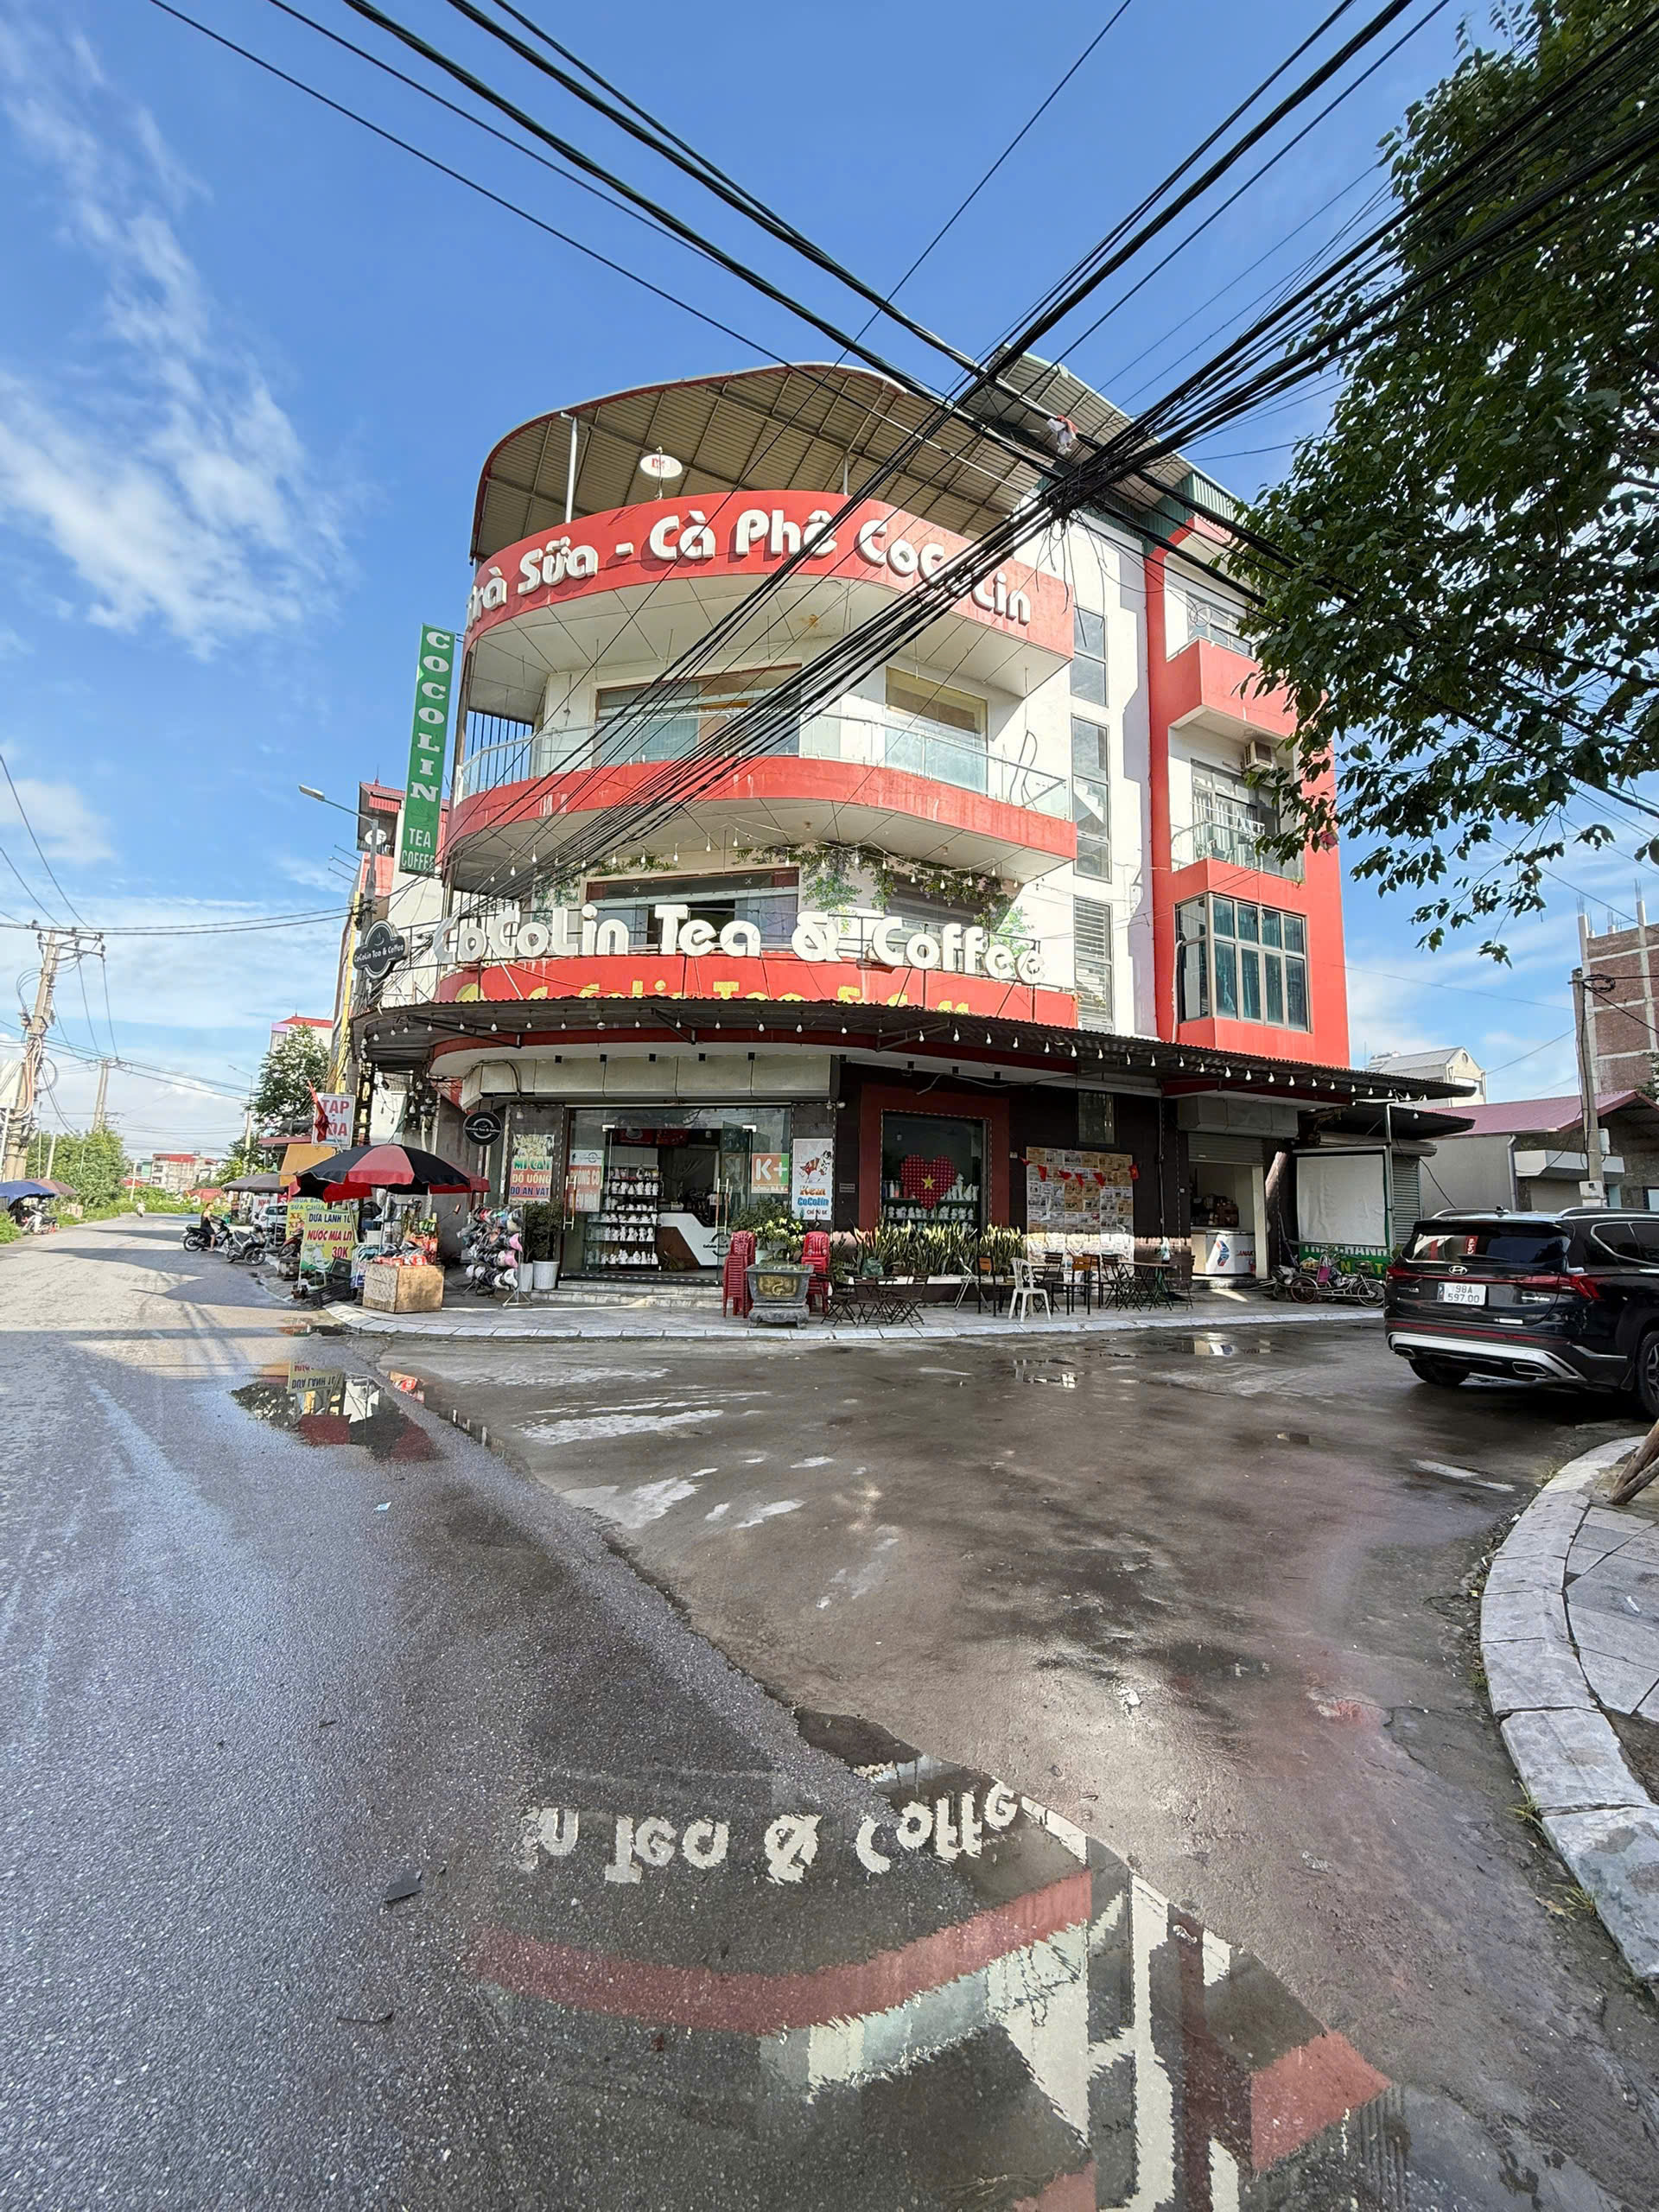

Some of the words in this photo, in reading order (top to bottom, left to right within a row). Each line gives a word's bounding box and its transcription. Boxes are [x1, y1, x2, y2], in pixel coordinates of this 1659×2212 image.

[518, 537, 599, 597] Sữa
[649, 511, 715, 560] Cà
[735, 509, 837, 557] Phê
[859, 518, 1032, 626] CoCLin
[410, 631, 450, 803] COCOLIN
[409, 827, 431, 849] TEA
[401, 849, 435, 870] COFFEE
[434, 904, 629, 965] CoCoLin
[654, 904, 761, 958] Tea
[791, 911, 842, 963] &
[872, 916, 1046, 985] Coffee
[755, 1158, 788, 1181] K+
[332, 1246, 348, 1258] 30K
[1447, 1293, 1480, 1303] 597.00
[1454, 1284, 1472, 1294] 98A
